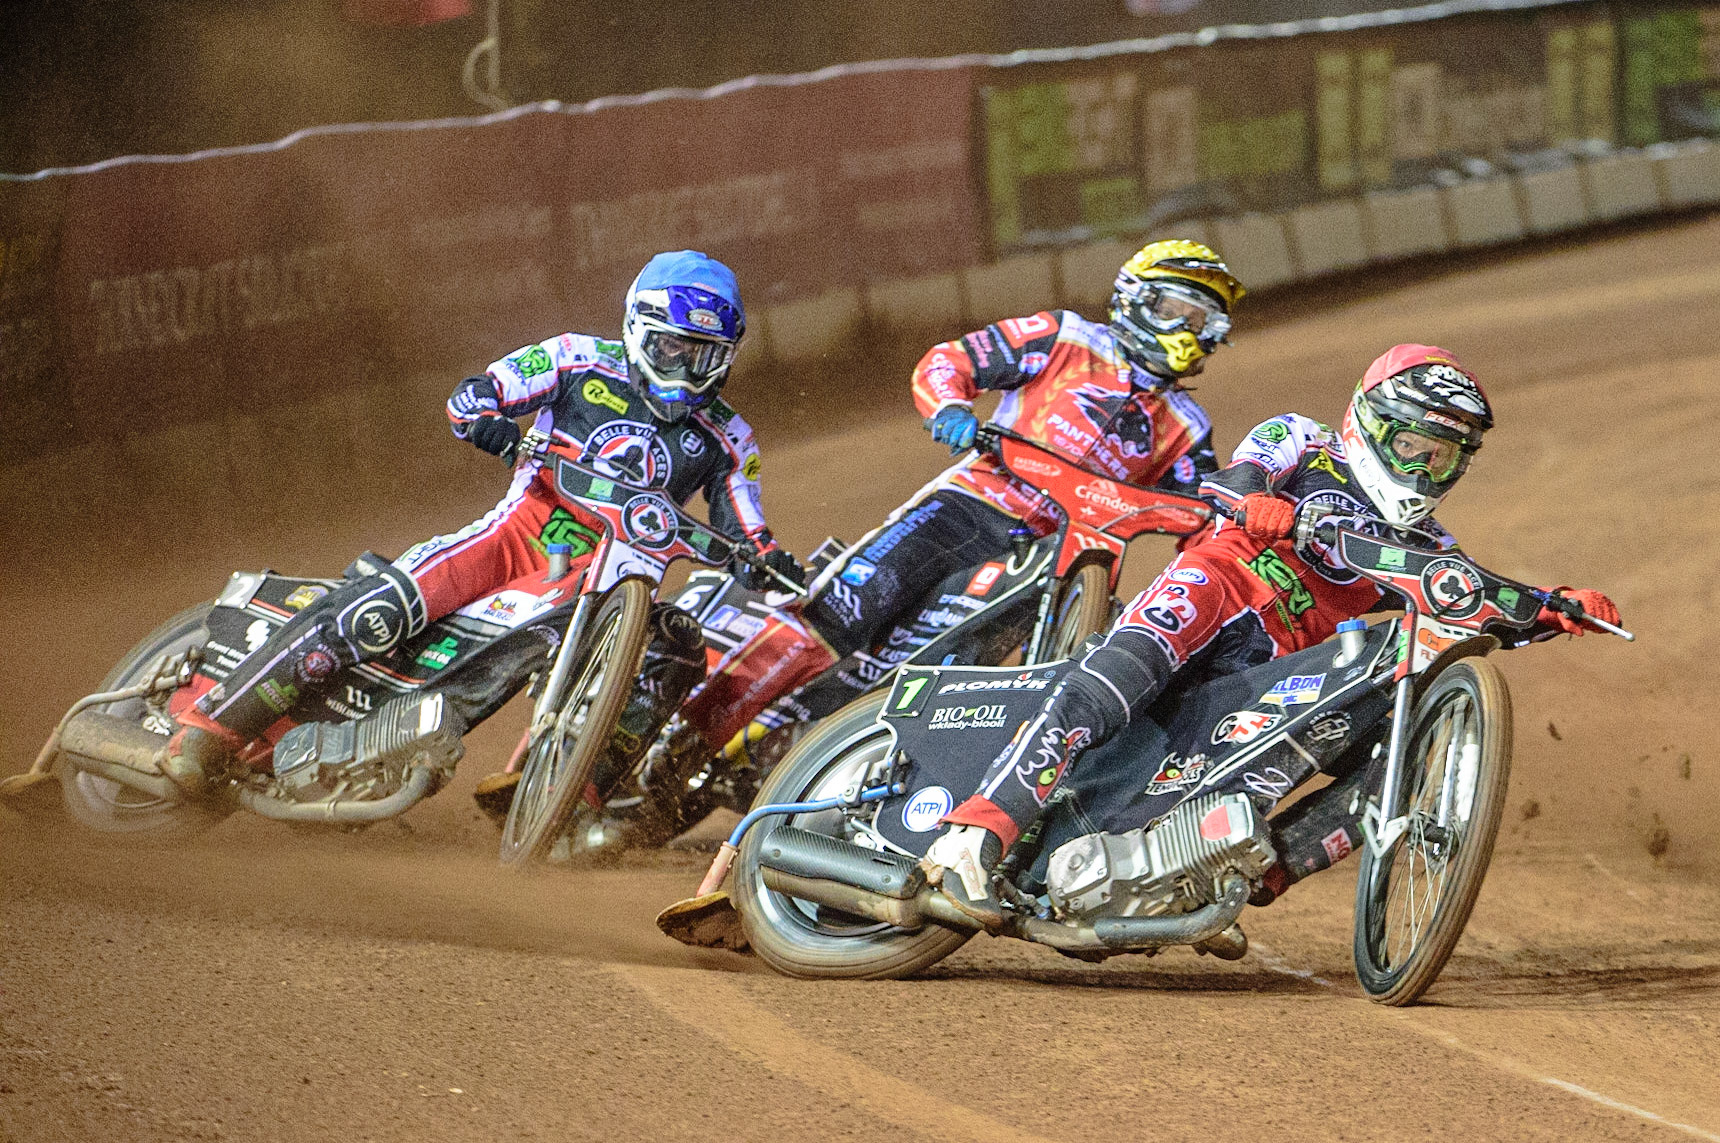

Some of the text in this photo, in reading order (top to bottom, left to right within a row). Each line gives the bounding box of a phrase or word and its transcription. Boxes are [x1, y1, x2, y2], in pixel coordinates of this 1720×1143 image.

[593, 425, 630, 446] BELLE
[652, 447, 667, 478] ACES
[1075, 485, 1140, 516] Crendon
[1426, 561, 1448, 577] BELLE
[1449, 561, 1466, 574] VUE
[220, 575, 255, 606] 2
[674, 584, 715, 611] 6
[363, 611, 392, 644] ATPI
[896, 677, 928, 710] 1
[913, 802, 942, 816] ATPI
